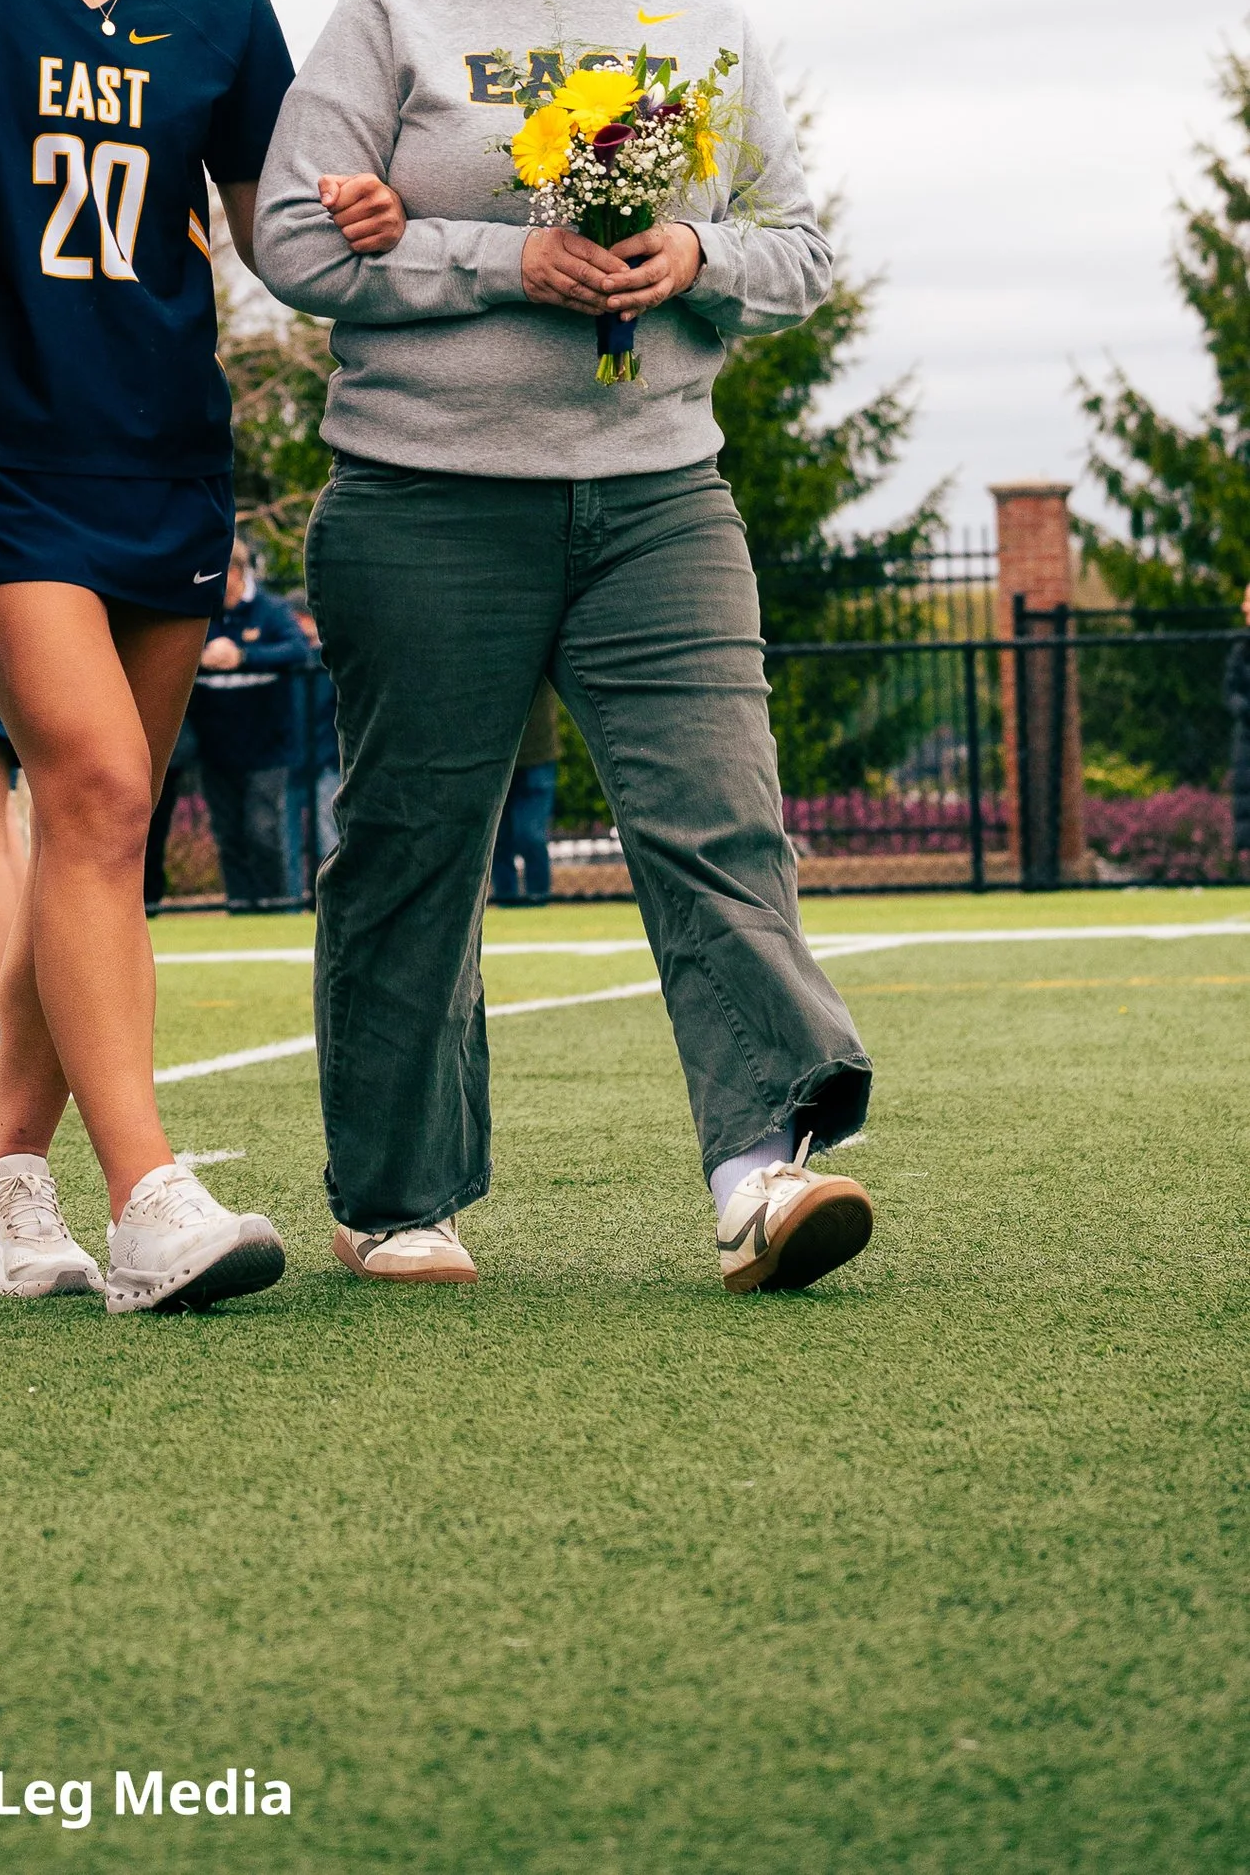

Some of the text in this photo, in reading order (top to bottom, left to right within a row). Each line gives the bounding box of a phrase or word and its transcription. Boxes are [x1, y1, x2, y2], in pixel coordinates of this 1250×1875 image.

[39, 56, 150, 129] EAST
[464, 49, 680, 107] EA
[32, 133, 150, 283] 20
